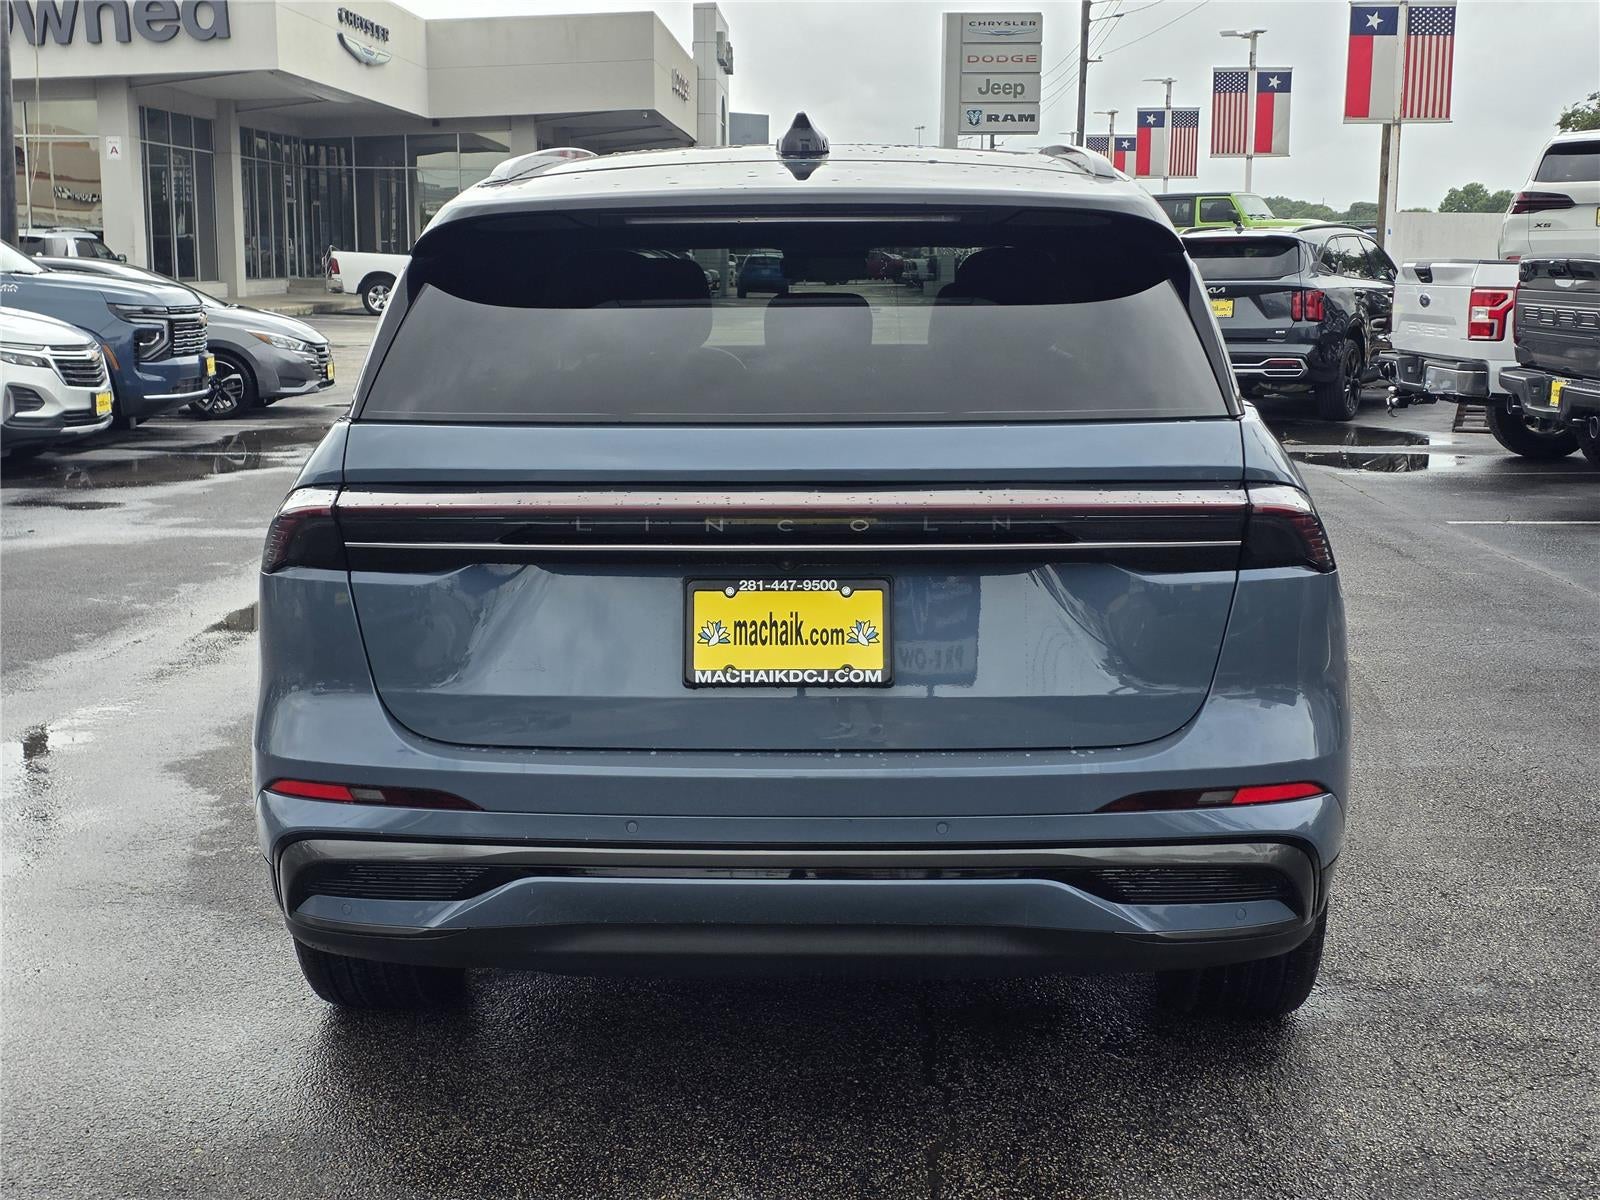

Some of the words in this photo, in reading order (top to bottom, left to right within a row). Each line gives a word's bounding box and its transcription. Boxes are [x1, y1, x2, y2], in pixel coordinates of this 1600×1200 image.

[9, 0, 231, 46] wned
[337, 7, 389, 42] CHRYSLER
[967, 54, 1038, 64] DODGE
[977, 78, 1026, 98] Jeep
[986, 113, 1036, 123] RAM
[110, 146, 119, 155] A
[1523, 306, 1600, 330] FORD
[576, 515, 1011, 533] LINCOLN
[739, 579, 838, 592] 281-447-9500
[733, 611, 846, 647] machaik.com
[694, 670, 883, 684] MACHAIKDCJ.COM
